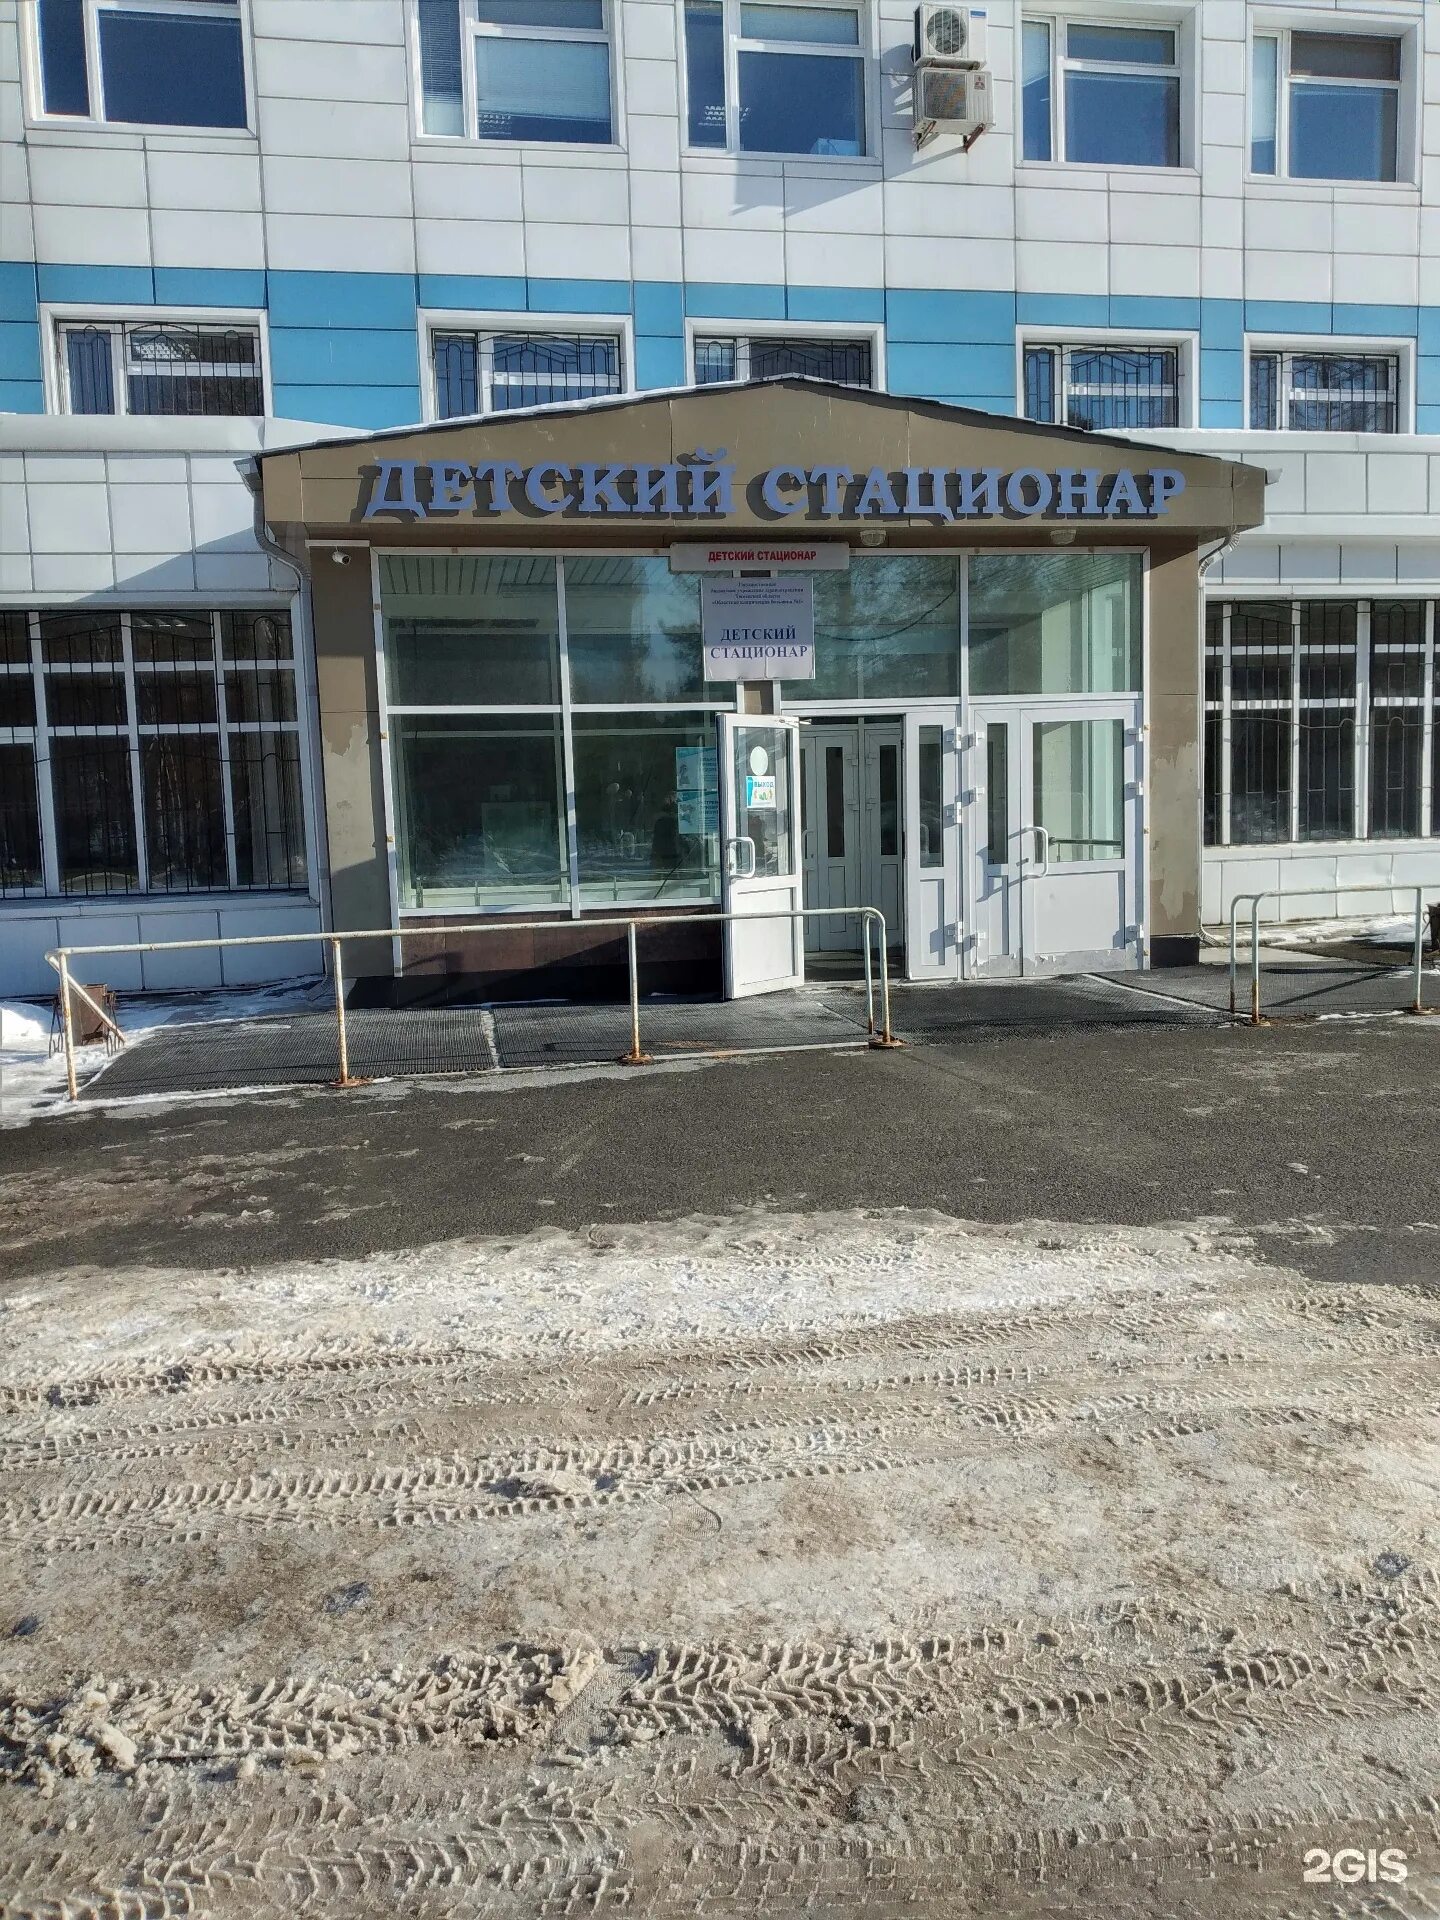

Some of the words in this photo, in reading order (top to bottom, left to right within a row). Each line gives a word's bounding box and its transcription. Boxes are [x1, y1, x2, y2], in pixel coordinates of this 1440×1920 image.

[364, 447, 736, 519] ДЕТСКИЙ
[762, 464, 1186, 522] СТАЦИОНАР
[708, 550, 754, 562] ДЕТСКИЙ
[757, 550, 816, 562] СТАЦИОНАР
[720, 625, 796, 642] ДЕТСКИЙ
[710, 645, 808, 660] СТАЦИОНАР
